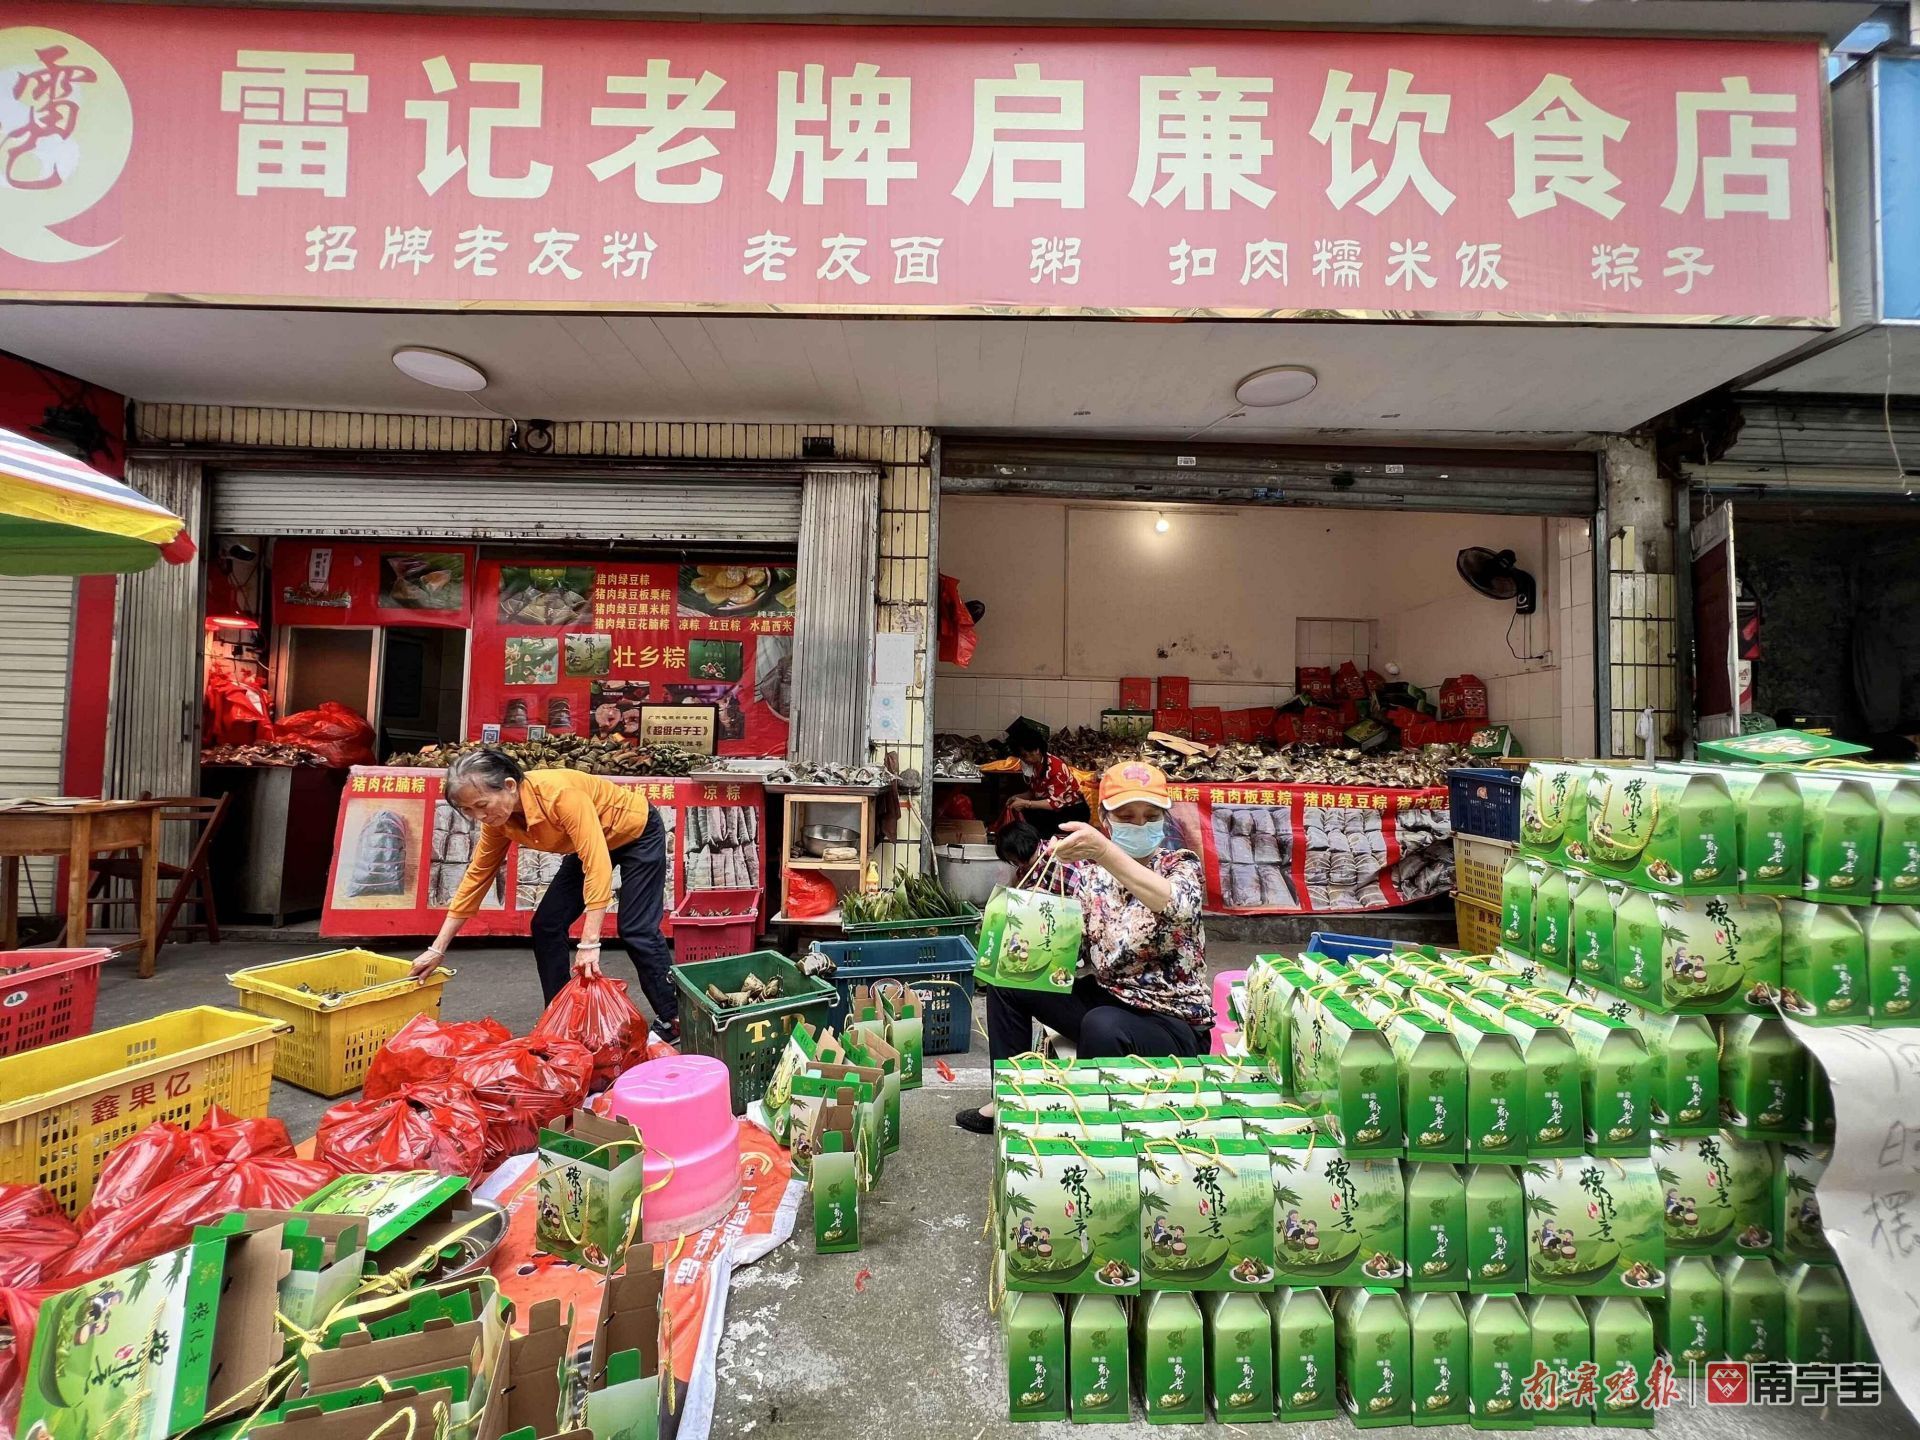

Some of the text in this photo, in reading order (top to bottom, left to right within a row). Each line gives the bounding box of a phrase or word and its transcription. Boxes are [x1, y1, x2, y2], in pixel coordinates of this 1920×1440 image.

[219, 49, 1799, 222] 雷记老牌启廉饮食店
[304, 225, 1715, 294] 招牌老友粉 老友面 粥 扣肉糯米饭 粽子
[596, 573, 651, 586] 猪肉绿豆粽
[595, 588, 672, 601] 猪肉绿豆板栗粽
[595, 603, 671, 616] 猪肉绿豆黑米粽
[678, 618, 701, 631] 凉粽
[708, 619, 742, 632] 红豆粽
[749, 619, 793, 633] 水晶西米
[613, 645, 686, 669] 壮乡粽
[646, 725, 709, 736] 《超级点子王》
[352, 775, 426, 794] 猪肉花腩粽
[1210, 788, 1293, 806] 猪肉板栗粽
[1303, 791, 1388, 810] 猪肉绿豆粽
[91, 1071, 191, 1126] 鑫果亿
